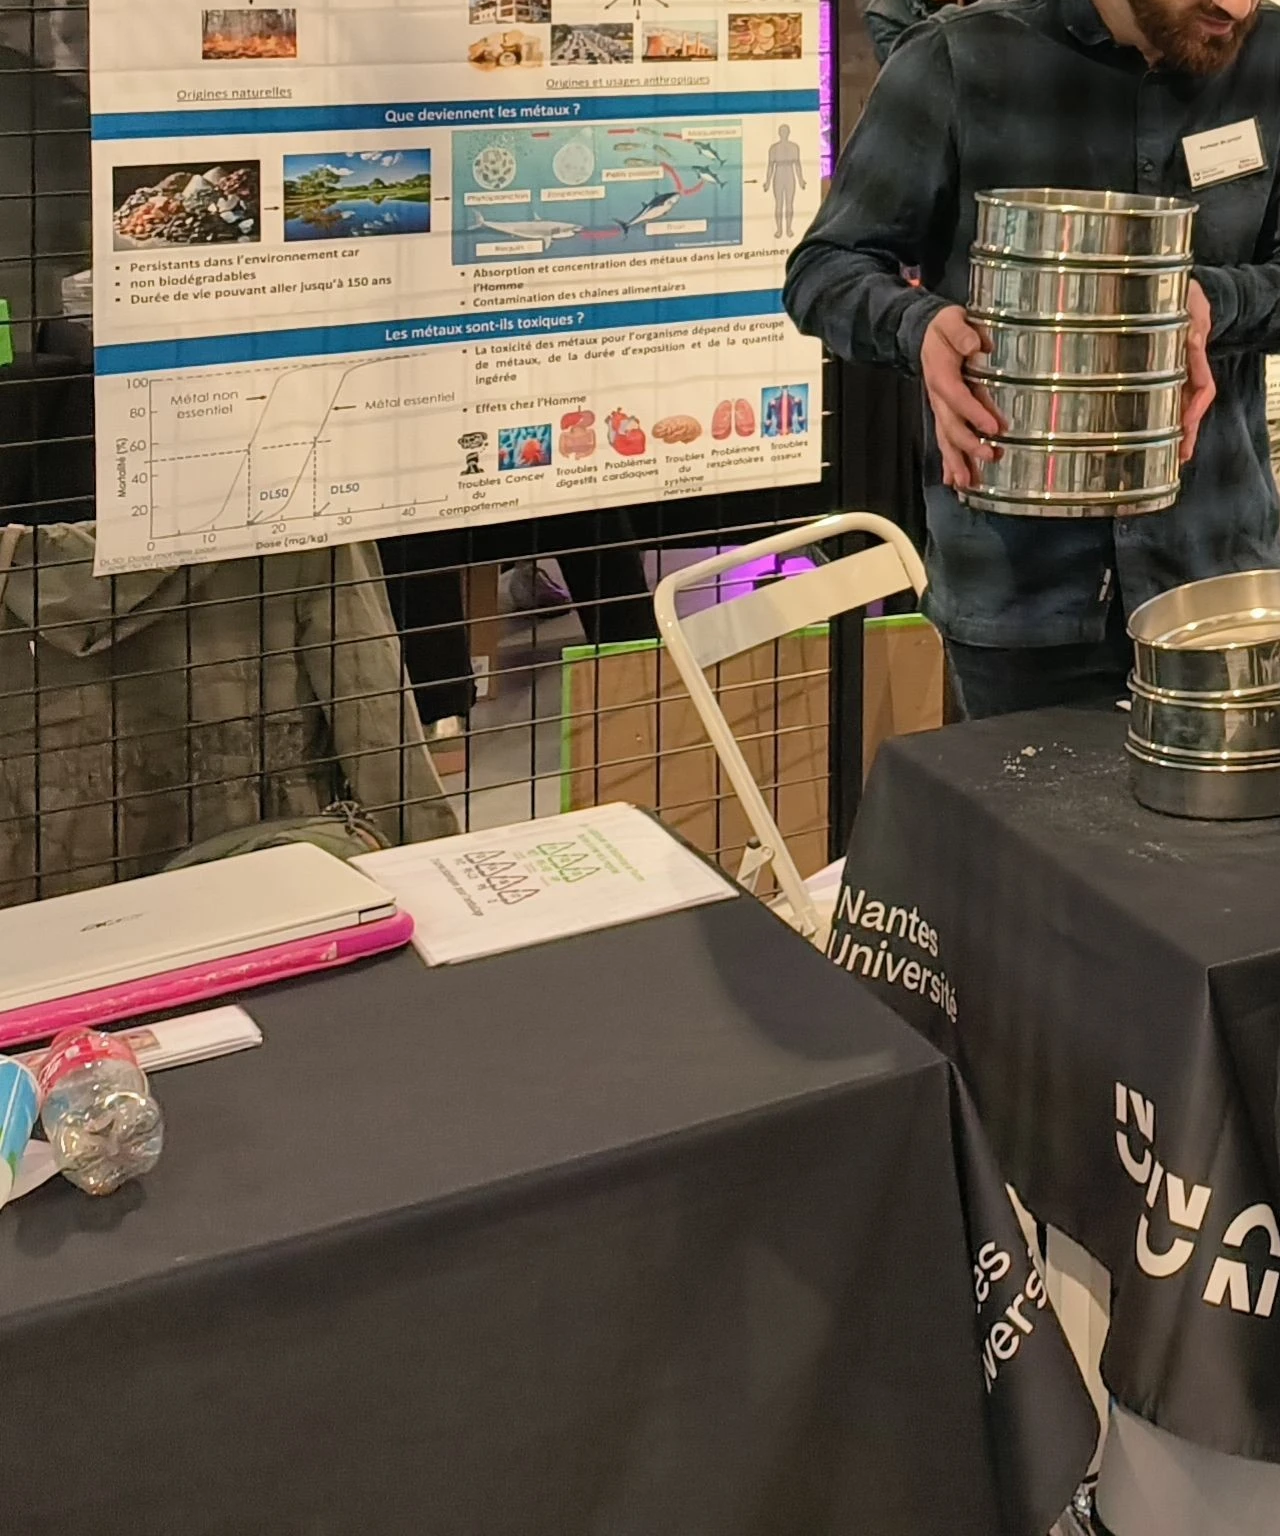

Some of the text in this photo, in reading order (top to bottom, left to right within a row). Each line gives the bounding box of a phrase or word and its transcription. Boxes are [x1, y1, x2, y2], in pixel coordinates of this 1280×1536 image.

[546, 74, 710, 89] Origines et usages anthropiques
[177, 86, 292, 100] Origines naturelles
[385, 103, 581, 123] Que deviennent les métaux ?
[130, 258, 200, 273] Persistants
[204, 256, 233, 267] dans
[342, 249, 359, 258] car
[131, 271, 256, 288] non biodégradables
[131, 292, 170, 305] Durée
[174, 290, 188, 300] de
[192, 290, 211, 300] vie
[215, 285, 266, 299] pouvant
[270, 283, 297, 294] aller
[347, 277, 368, 288] 150
[372, 276, 392, 286] ans
[473, 282, 686, 308] Contamination des chaînes alimentaires
[386, 313, 584, 341] Les métaux sont-ils toxiques ?
[126, 378, 149, 388] 100
[404, 392, 455, 407] essentiel
[475, 402, 507, 415] Effets
[510, 400, 534, 410] chez
[505, 473, 544, 485] Cancer
[556, 465, 598, 476] Troubles
[260, 488, 289, 501] DL50
[256, 532, 328, 550] Dose (mg/kg)
[837, 885, 939, 957] Nantes
[827, 928, 959, 1023] Université
